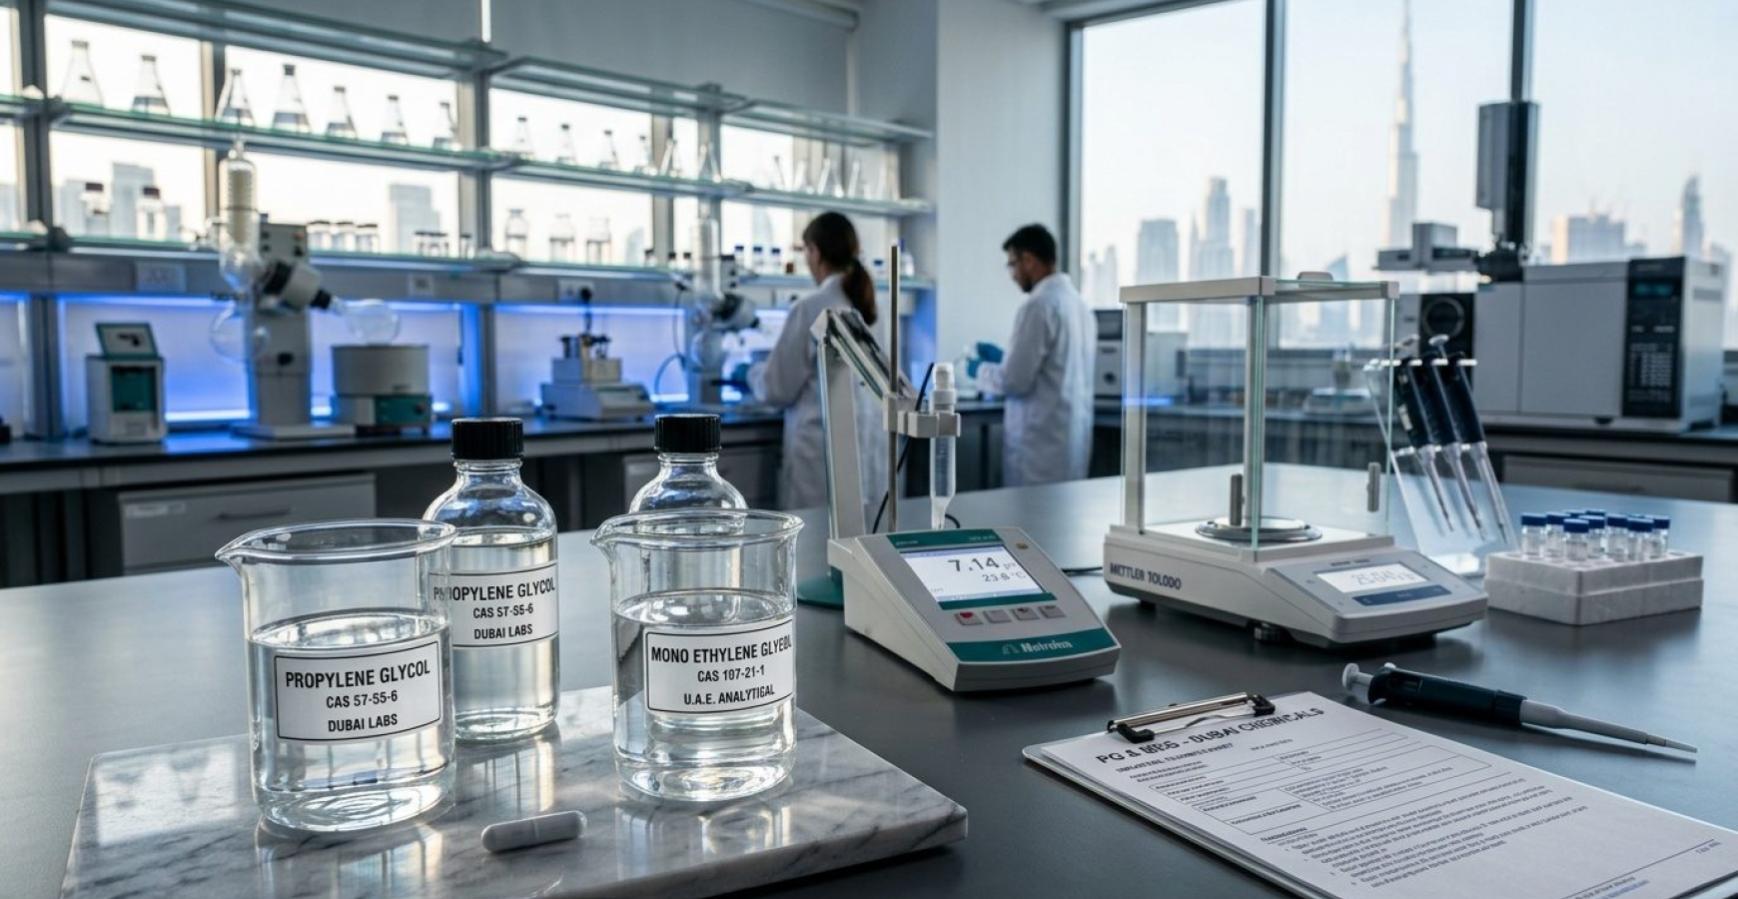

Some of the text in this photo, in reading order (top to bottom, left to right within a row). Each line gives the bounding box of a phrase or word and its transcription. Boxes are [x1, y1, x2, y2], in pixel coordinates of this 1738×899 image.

[947, 556, 1000, 573] 7.14
[517, 577, 556, 598] GLYCOL
[473, 607, 495, 619] CAS
[474, 623, 533, 640] DUBAI LABS
[651, 646, 689, 663] MONO
[693, 645, 758, 663] ETHYLENE
[285, 659, 431, 688] PROPYLENE GLYCOL
[697, 664, 765, 682] CAS 107-21-1
[326, 695, 350, 708] CAS
[683, 693, 716, 705] U.A.E.
[328, 713, 398, 732] DUBAI LABS
